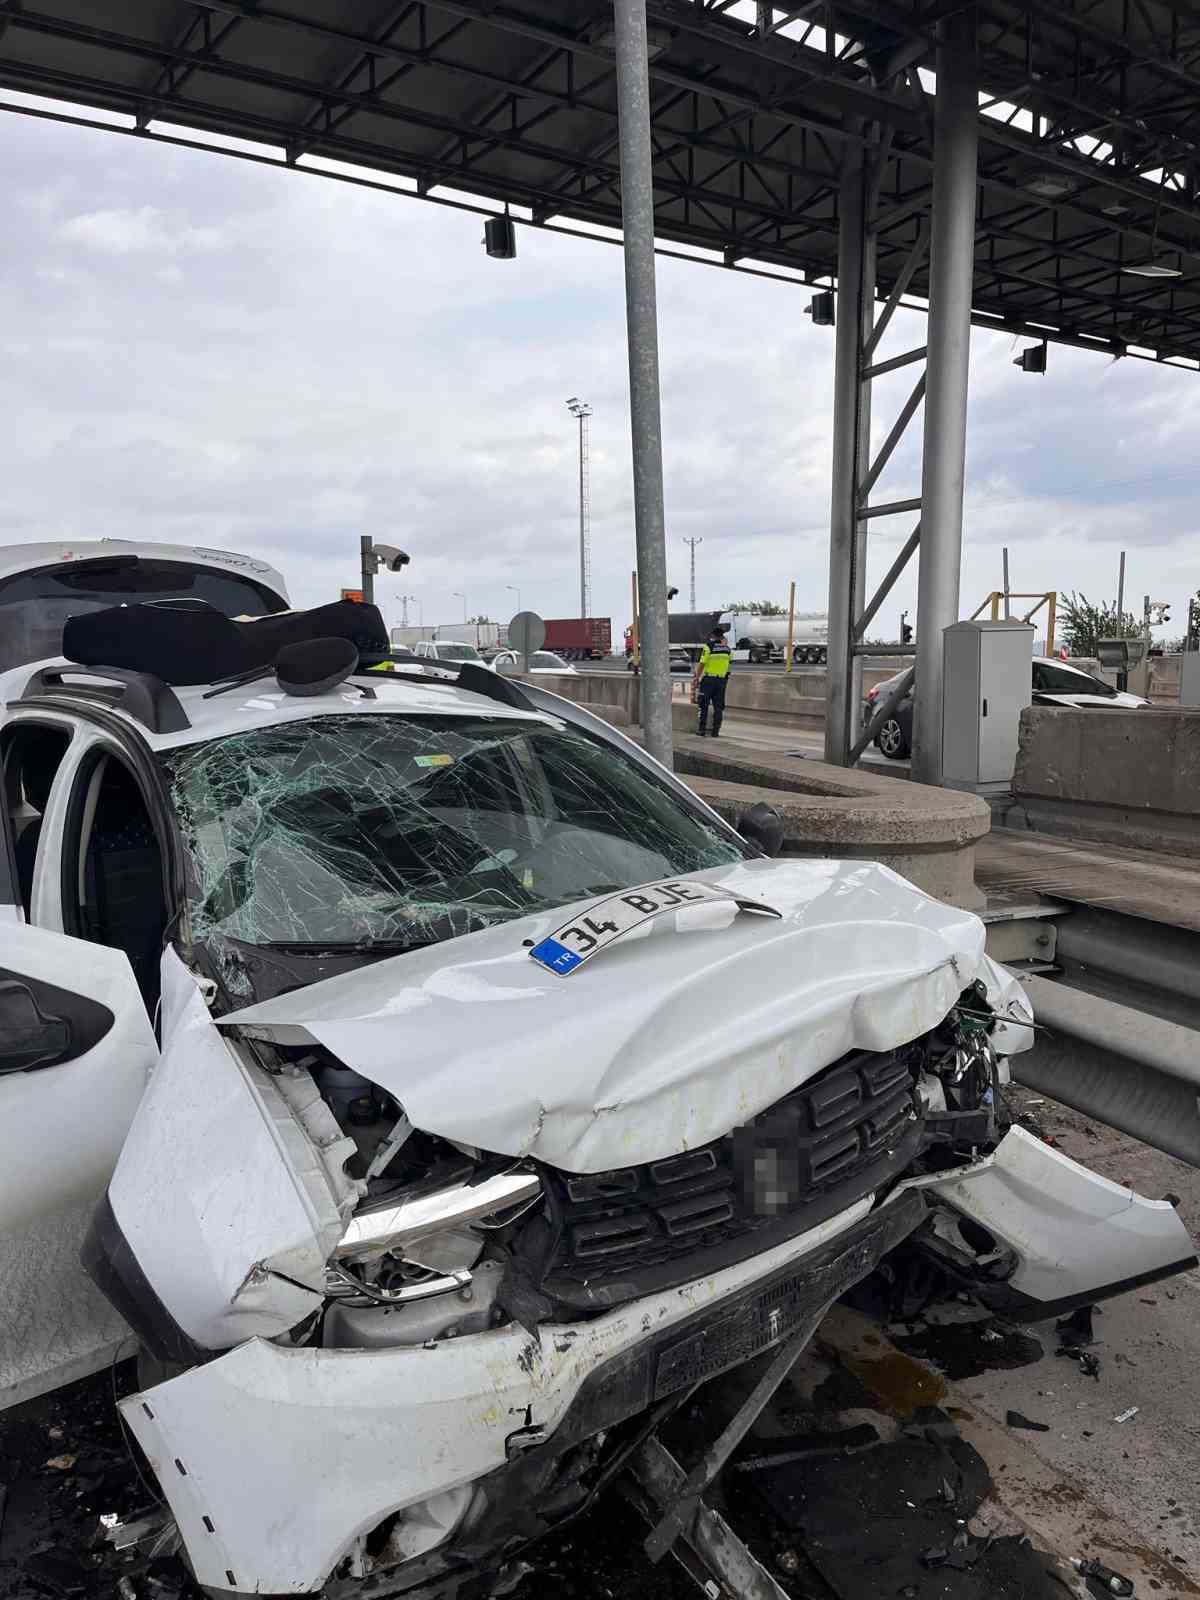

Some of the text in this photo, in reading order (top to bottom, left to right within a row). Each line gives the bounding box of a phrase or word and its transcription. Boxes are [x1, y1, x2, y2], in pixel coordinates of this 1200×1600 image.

[553, 884, 705, 967] TR 34 BJE
